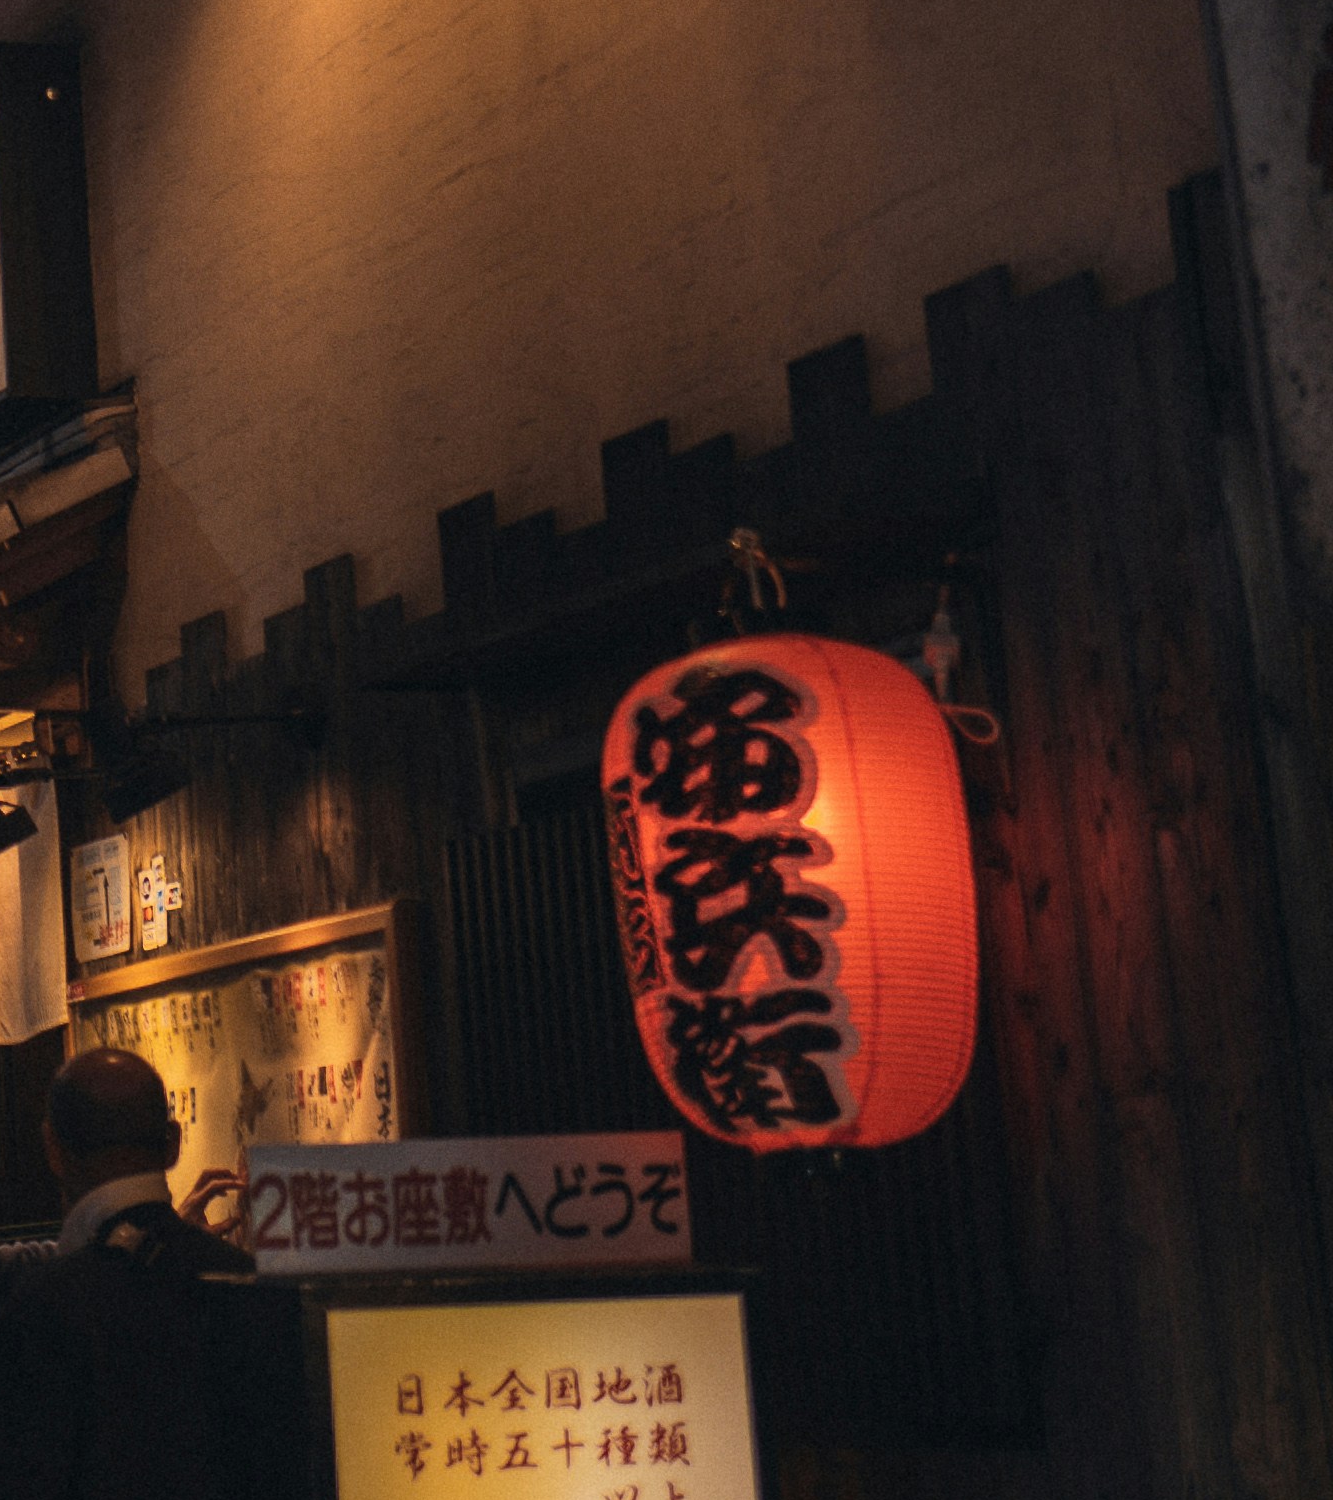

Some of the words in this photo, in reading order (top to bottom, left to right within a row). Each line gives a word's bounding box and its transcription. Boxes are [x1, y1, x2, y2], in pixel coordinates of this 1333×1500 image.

[255, 1161, 682, 1251] 2階お座敷へどうぞ
[395, 1363, 685, 1417] 日本全国地酒
[394, 1420, 692, 1481] 常時五十種類
